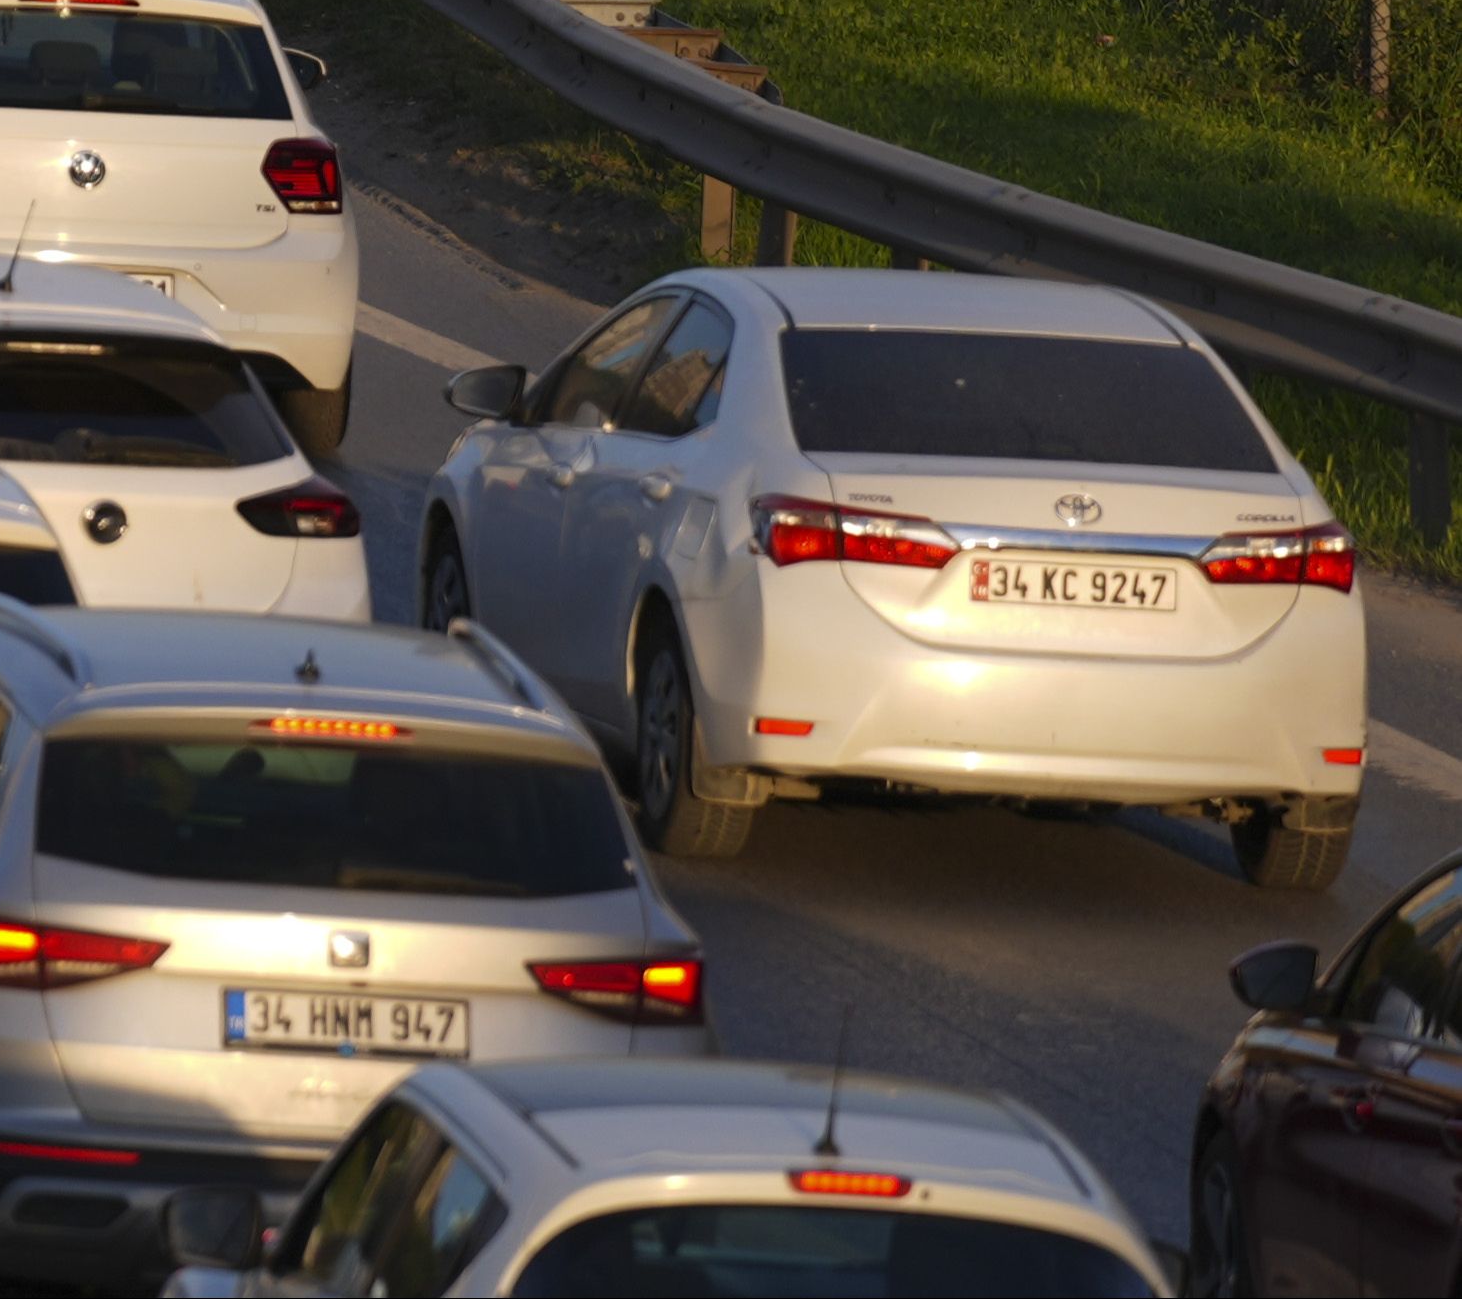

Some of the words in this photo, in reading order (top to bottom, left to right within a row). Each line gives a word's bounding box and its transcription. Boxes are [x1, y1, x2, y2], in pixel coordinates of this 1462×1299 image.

[847, 493, 893, 504] TOYOTA
[991, 565, 1028, 601] 34
[1041, 568, 1078, 603] KC
[1091, 570, 1167, 608] 9247
[250, 997, 292, 1034] 34
[307, 1001, 372, 1039] HNM
[389, 1005, 453, 1044] 947
